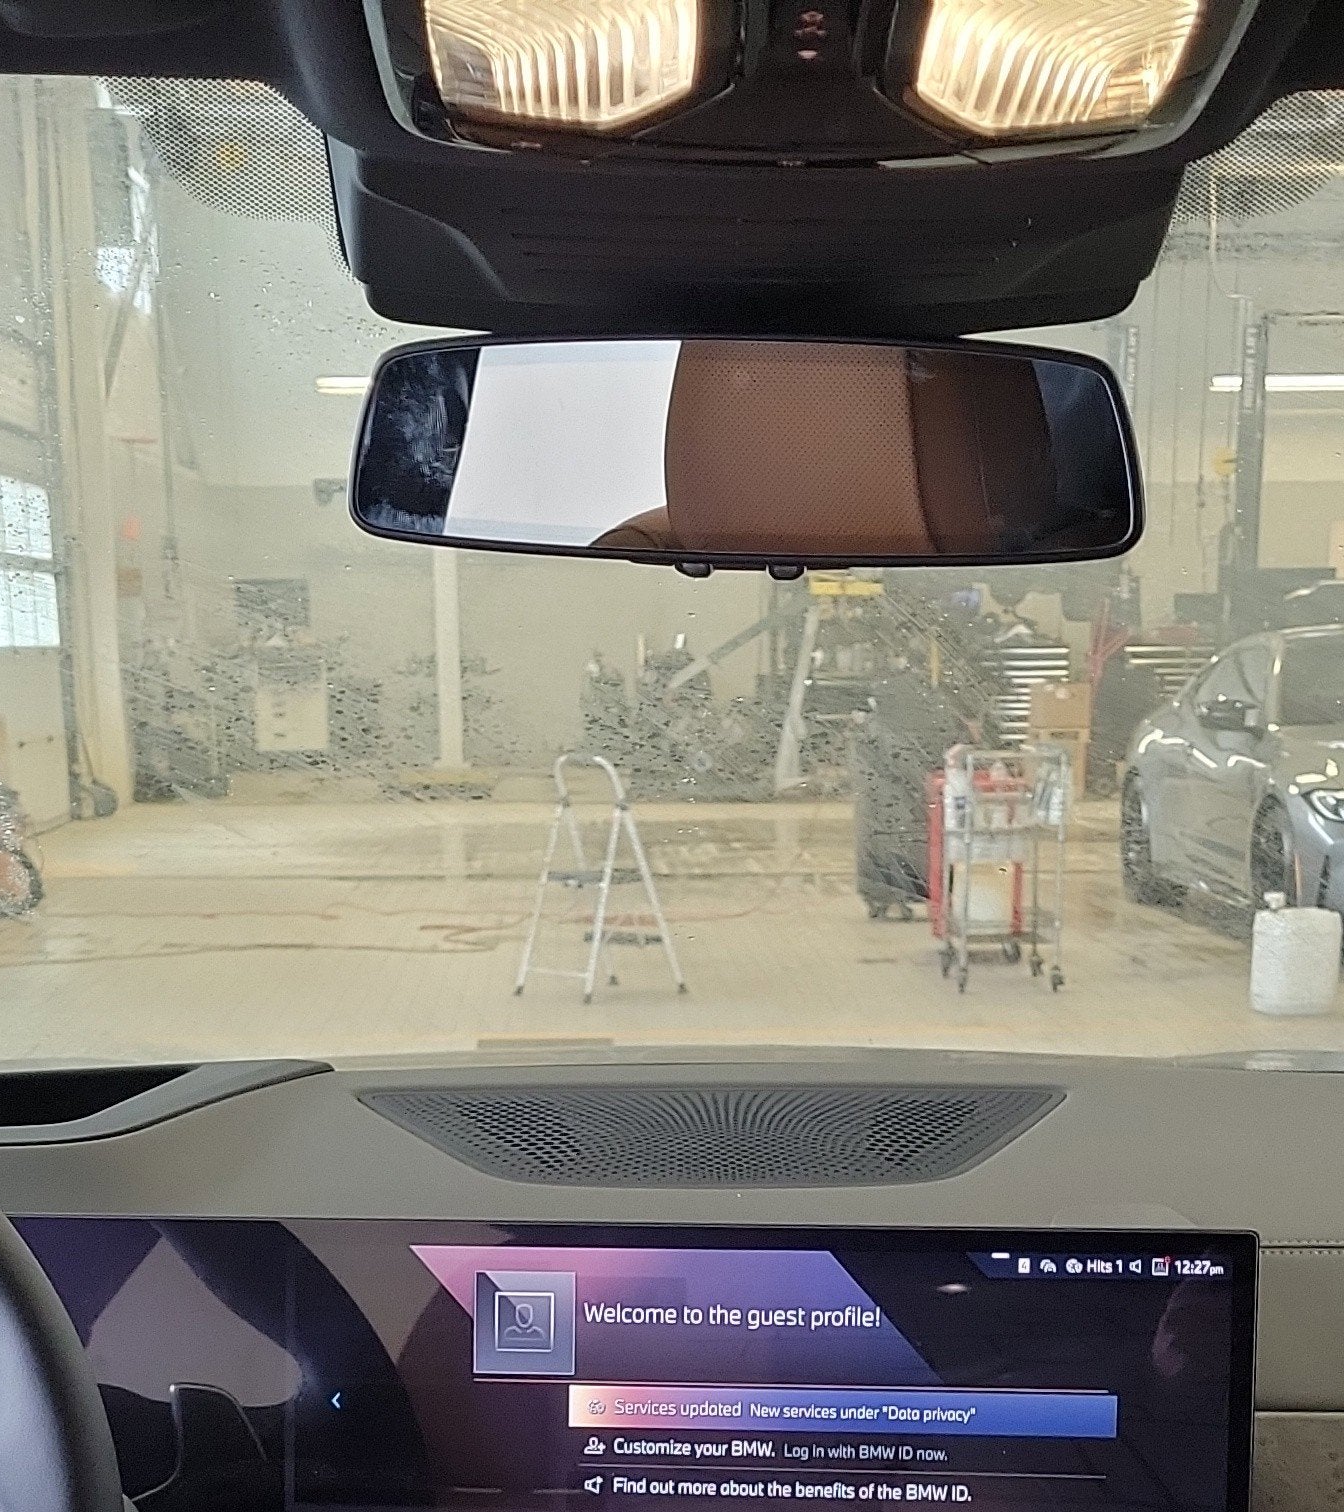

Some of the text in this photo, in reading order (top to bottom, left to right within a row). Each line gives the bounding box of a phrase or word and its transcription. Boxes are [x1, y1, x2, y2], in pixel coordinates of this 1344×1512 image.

[1086, 1259, 1123, 1273] Hits 1
[1174, 1259, 1224, 1276] 12:27pm
[583, 1302, 881, 1331] Welcome to the guest profile!
[614, 1400, 742, 1421] Services updated
[750, 1405, 976, 1424] New services under "Data privacy"
[613, 1438, 776, 1461] Customize your BMW.
[784, 1445, 948, 1462] Log in with BMW ID now.
[612, 1477, 973, 1502] Find out more about the benefits of the BMW ID.
